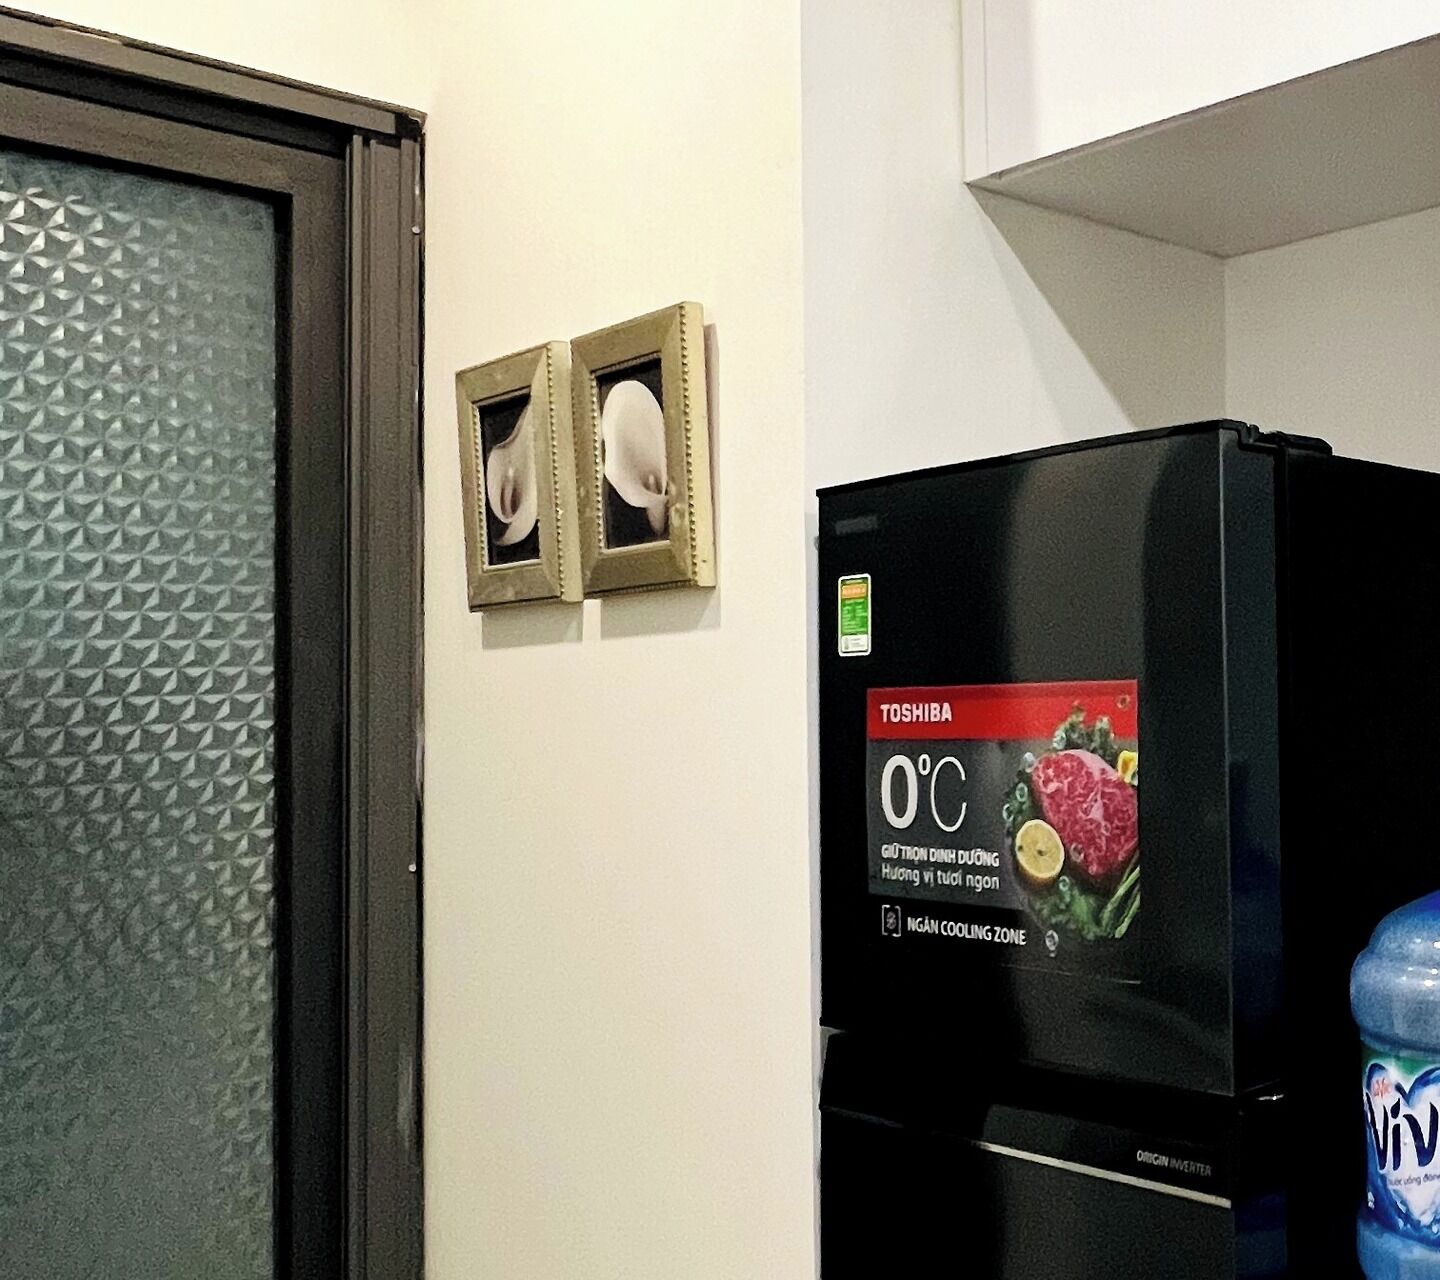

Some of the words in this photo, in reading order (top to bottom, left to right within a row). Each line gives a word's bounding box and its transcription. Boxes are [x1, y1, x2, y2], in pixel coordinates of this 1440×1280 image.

[880, 703, 952, 722] TOSHIBA
[923, 867, 935, 887] vị
[966, 874, 1000, 892] ngon
[940, 921, 992, 941] COOLING
[993, 926, 1027, 945] ZONE
[1137, 1150, 1169, 1167] ORIGIN
[1169, 1157, 1212, 1176] INVERTER
